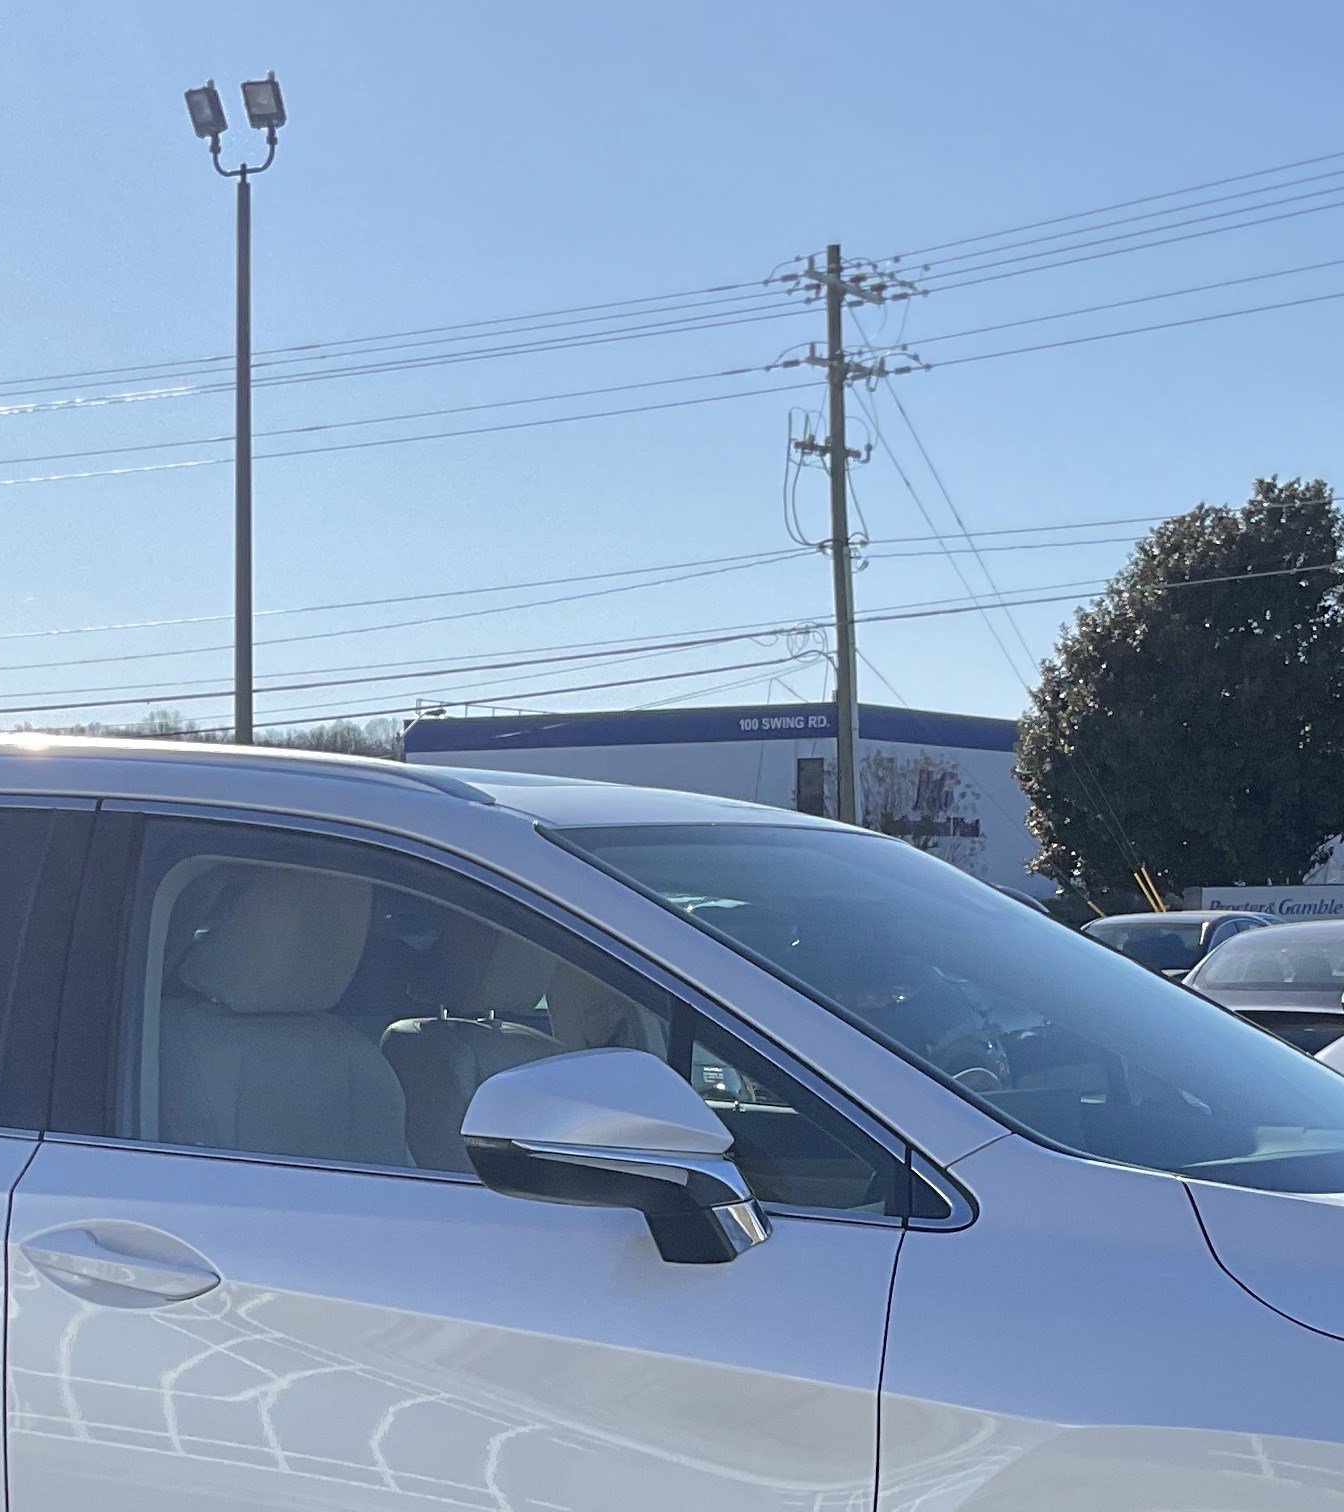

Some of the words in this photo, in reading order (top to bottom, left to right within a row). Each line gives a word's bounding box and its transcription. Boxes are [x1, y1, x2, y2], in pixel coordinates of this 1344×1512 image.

[739, 718, 759, 731] 100
[762, 716, 805, 730] SWING
[808, 715, 831, 729] RD.
[1278, 898, 1344, 915] Gamble
